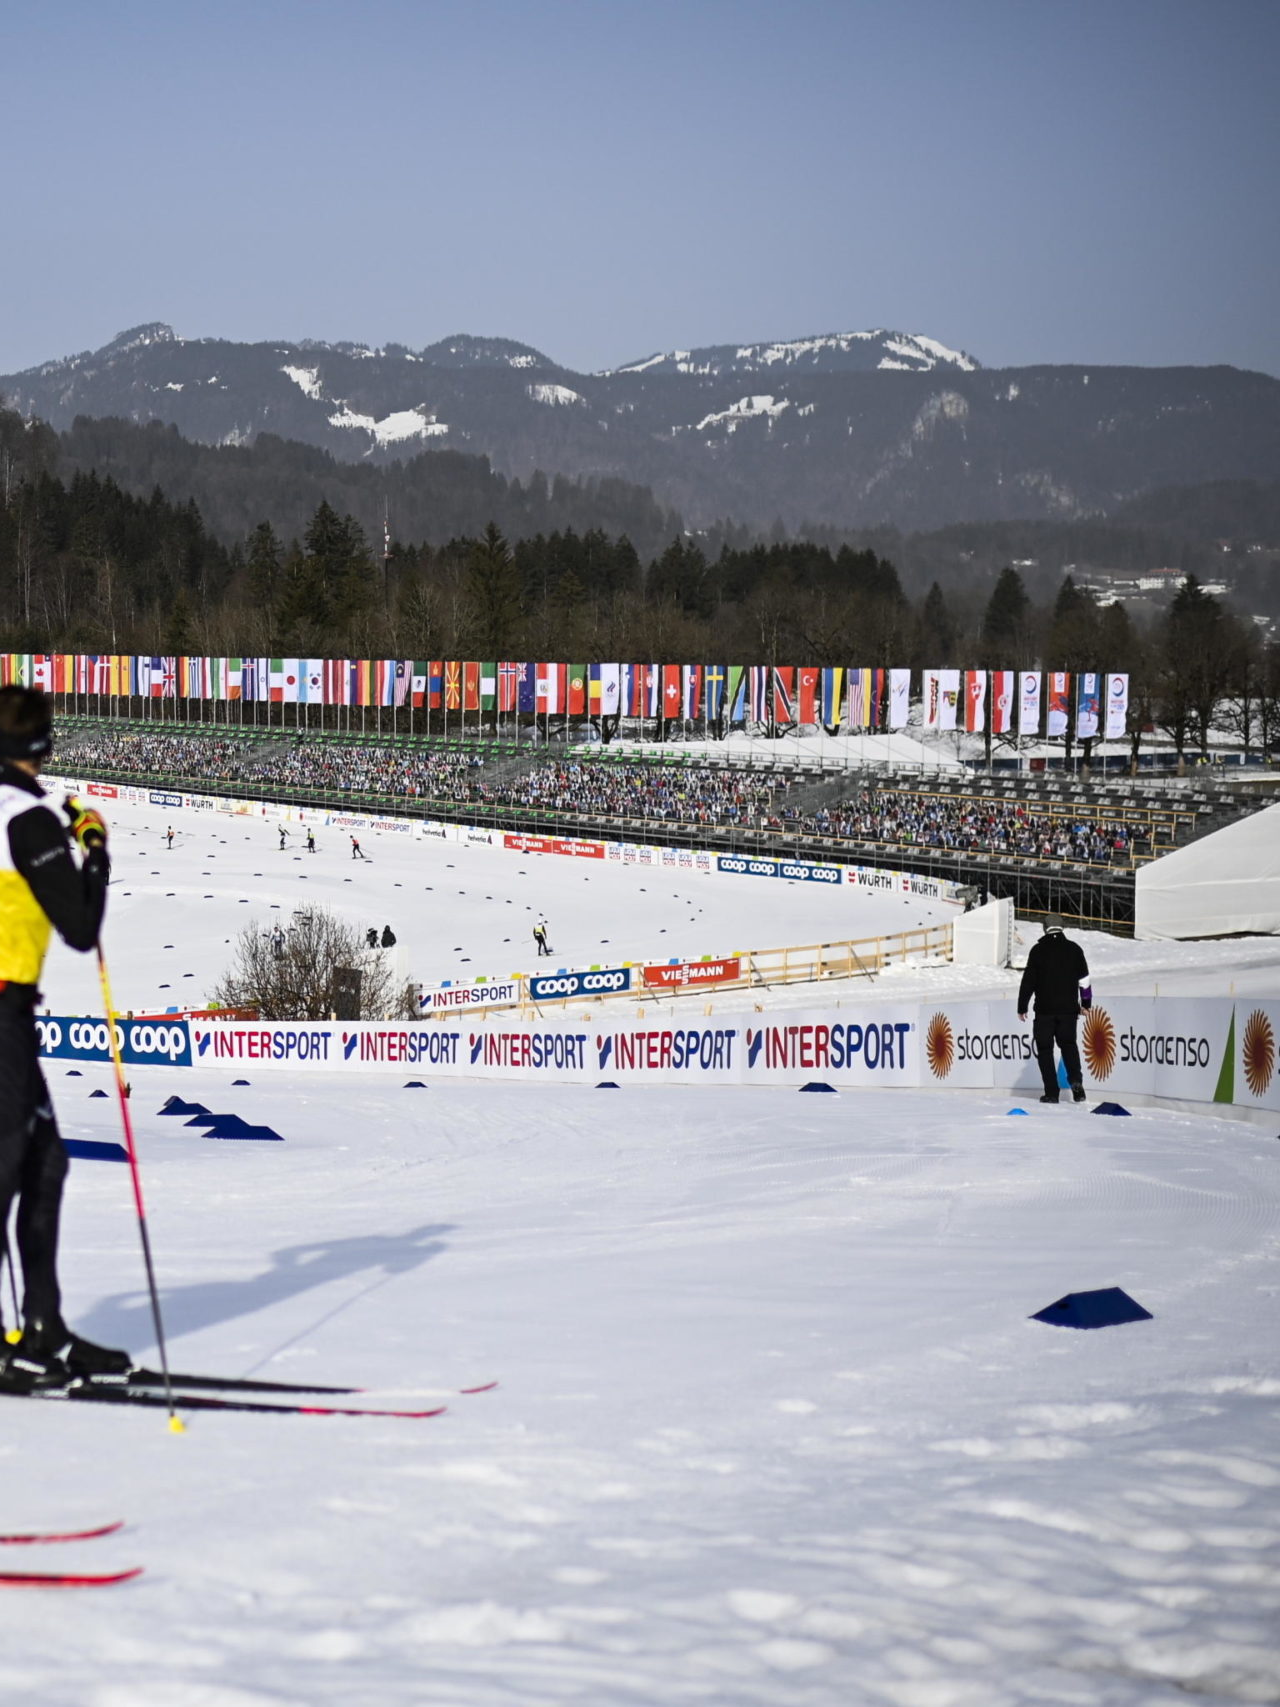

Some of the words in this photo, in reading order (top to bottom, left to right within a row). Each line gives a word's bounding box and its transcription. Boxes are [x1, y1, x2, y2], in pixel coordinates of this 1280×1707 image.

[721, 859, 746, 872] coop
[749, 862, 775, 876] coop
[783, 866, 809, 879] coop
[812, 869, 838, 882] coop
[858, 873, 892, 889] WÜRTH
[911, 881, 938, 897] WÜRTH
[536, 976, 579, 998] coop
[583, 971, 625, 993] coop
[660, 964, 724, 985] VIESSMANN
[433, 985, 515, 1007] INTERSPORT
[130, 1025, 186, 1061] coop
[213, 1030, 332, 1060] INTERSPORT
[360, 1031, 460, 1064] INTERSPORT
[484, 1032, 587, 1069] INTERSPORT
[614, 1029, 736, 1070] INTERSPORT
[765, 1022, 910, 1070] INTERSPORT
[1120, 1025, 1210, 1068] storaenso
